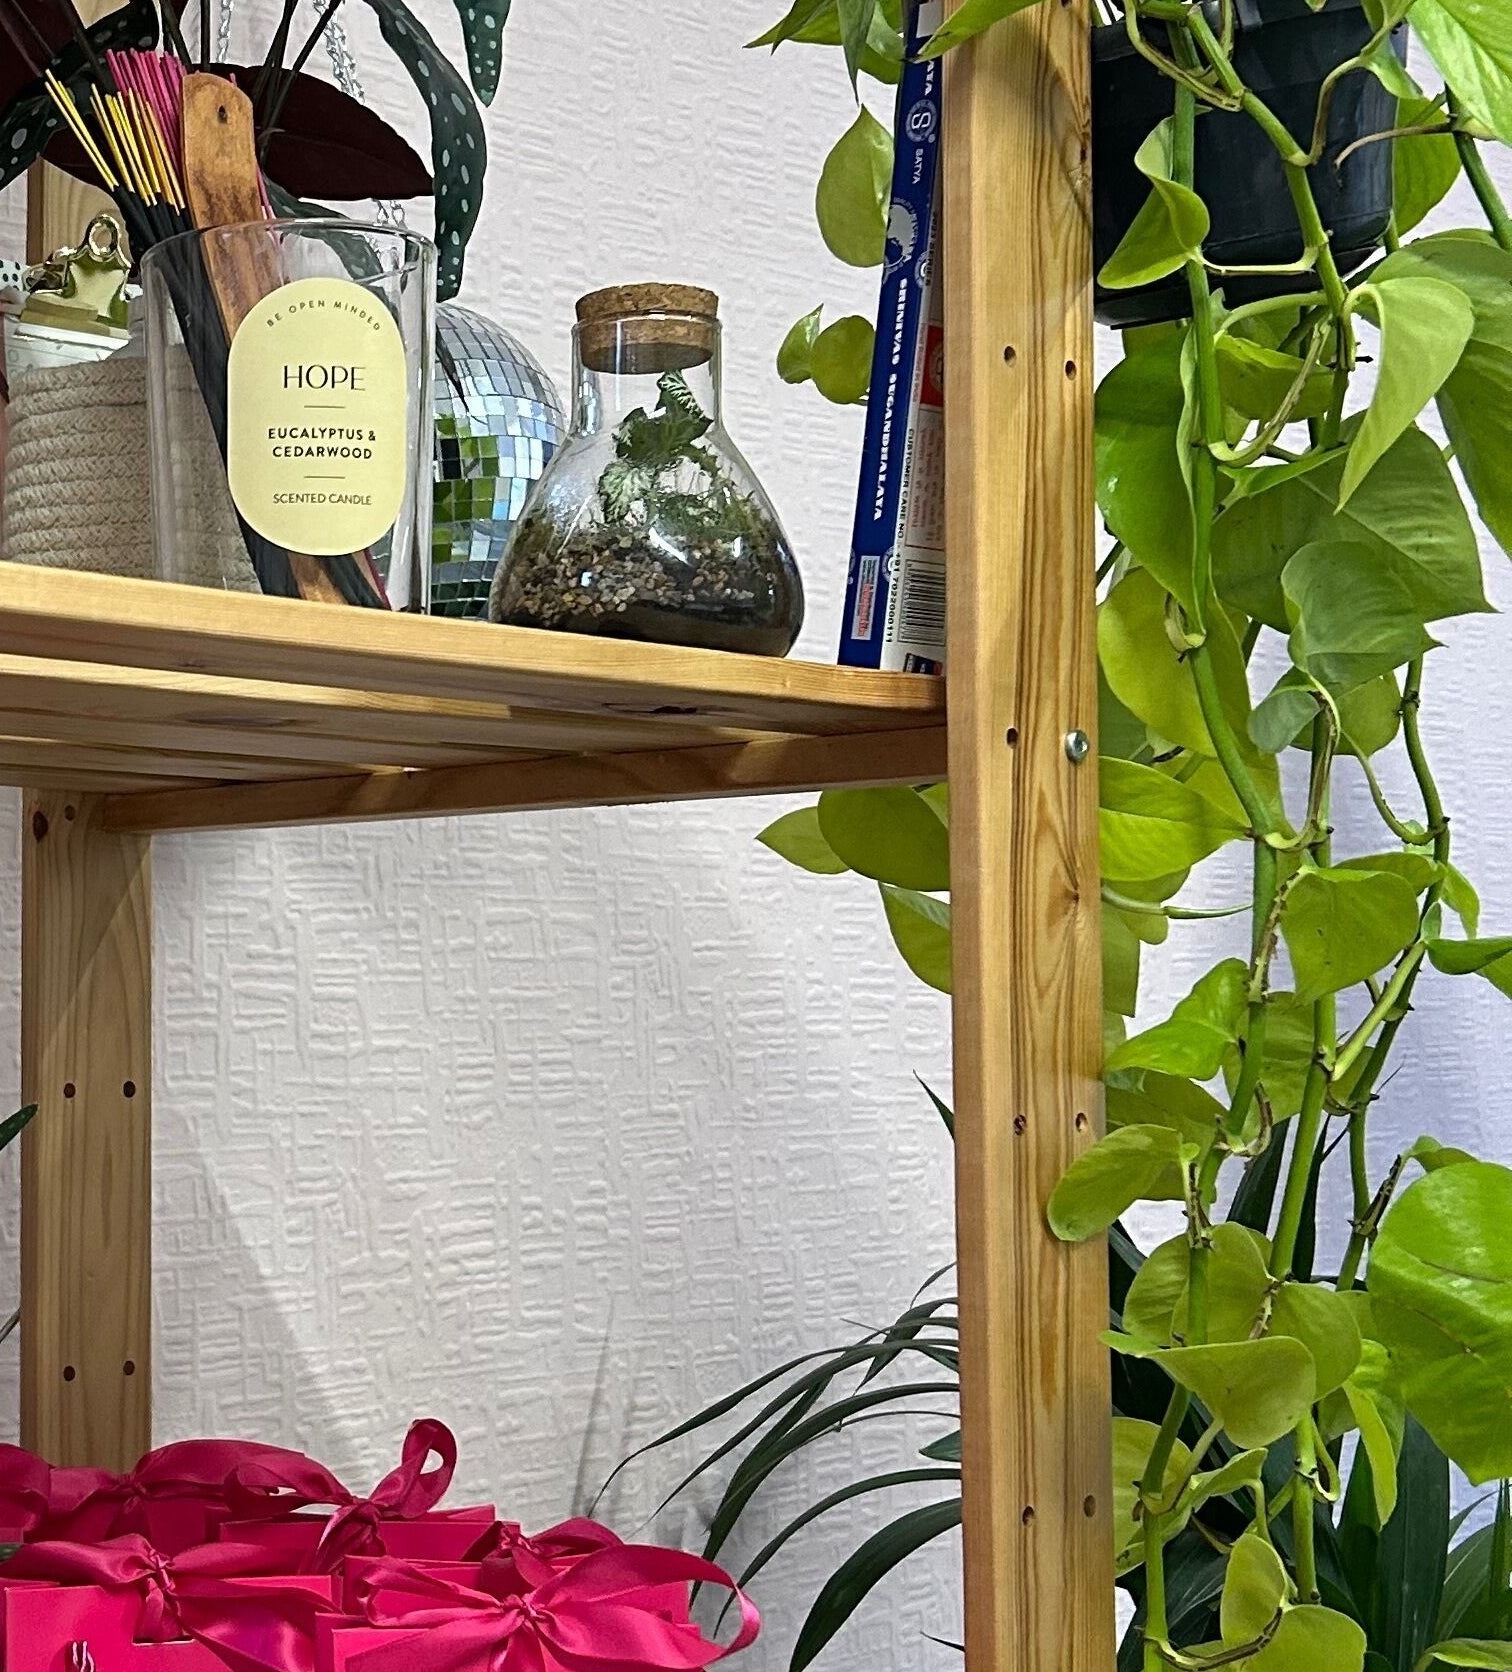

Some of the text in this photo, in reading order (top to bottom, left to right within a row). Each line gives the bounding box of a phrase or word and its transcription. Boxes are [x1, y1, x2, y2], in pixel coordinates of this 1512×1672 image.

[912, 148, 923, 185] SATYA
[266, 300, 381, 331] BE OPEN MINDED
[283, 364, 366, 391] HOPE
[268, 427, 376, 441] EUCALYPTUS &
[272, 446, 372, 459] CEDARWOOD
[903, 428, 915, 488] CUSTOMER
[273, 493, 372, 506] SCENTED CANDLE
[899, 490, 909, 521] CARE
[897, 523, 905, 539] NO
